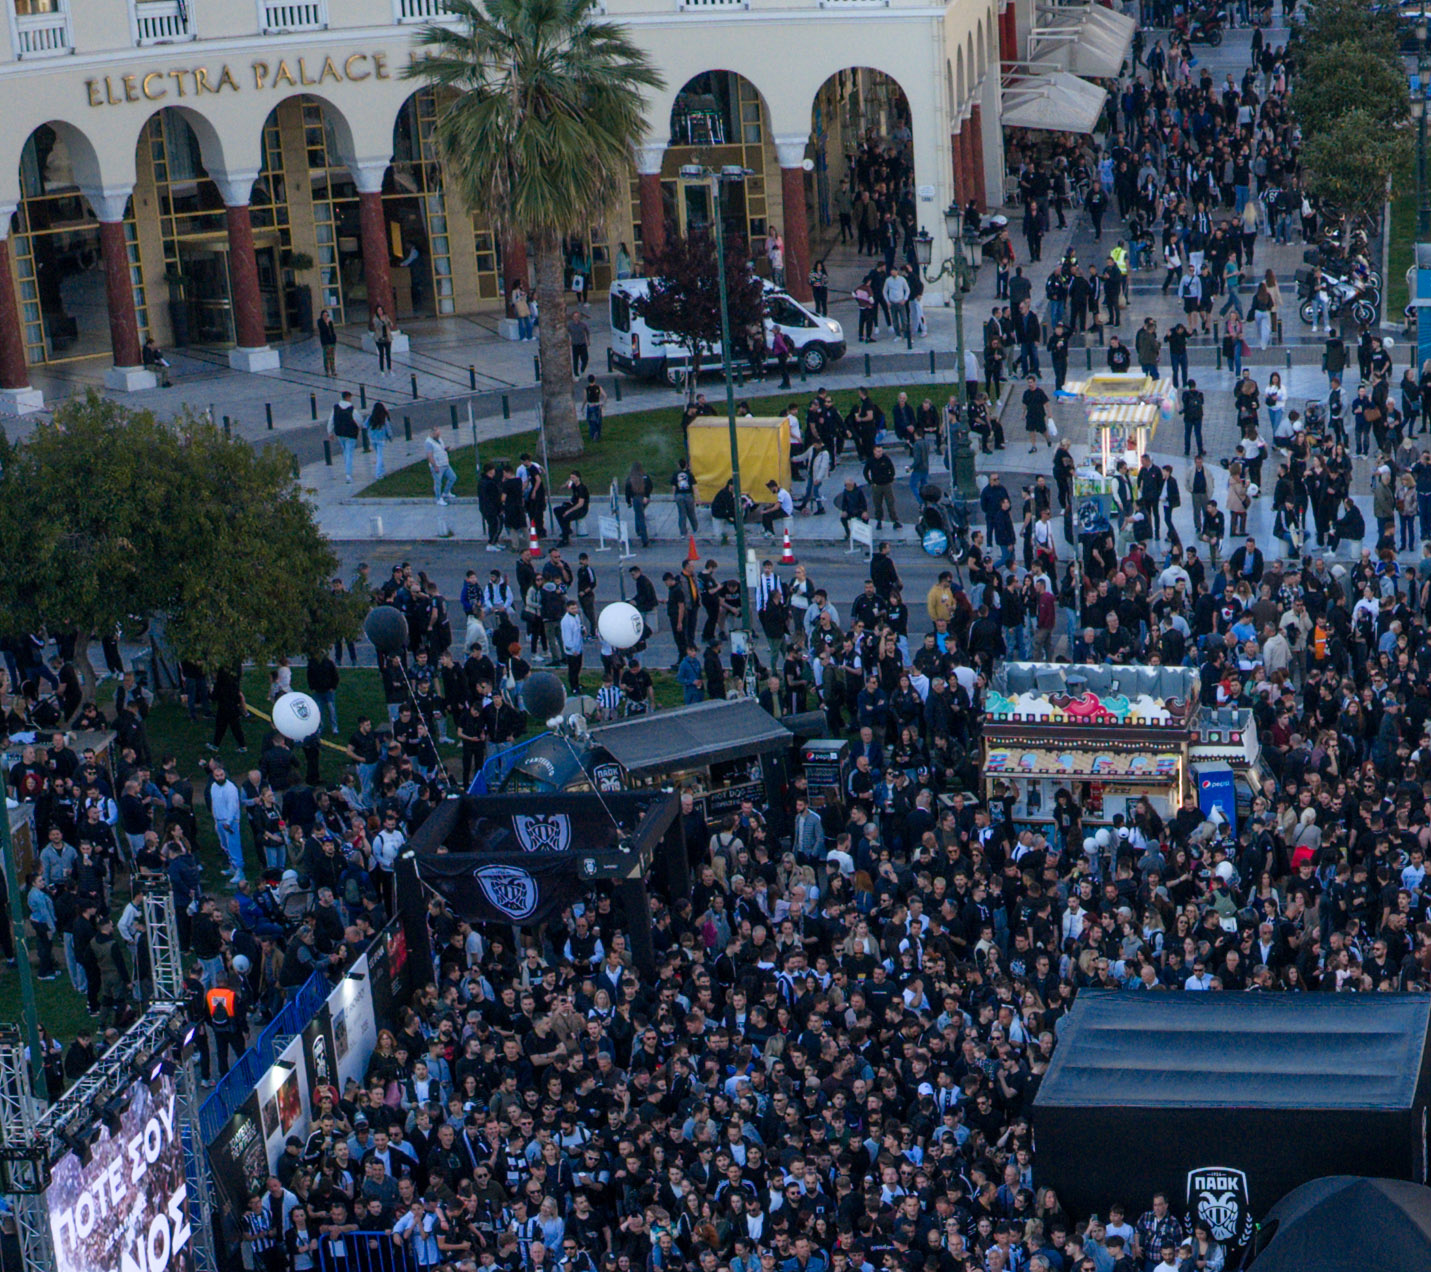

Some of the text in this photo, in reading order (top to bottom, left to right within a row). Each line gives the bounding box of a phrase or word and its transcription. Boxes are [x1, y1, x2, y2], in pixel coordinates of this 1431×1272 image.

[85, 63, 240, 108] ELECTRA
[253, 52, 391, 91] PALACE
[1212, 780, 1230, 788] pepsi
[128, 1094, 174, 1183] ΣΟΥ
[1195, 1177, 1239, 1191] ΠΑΟΚ
